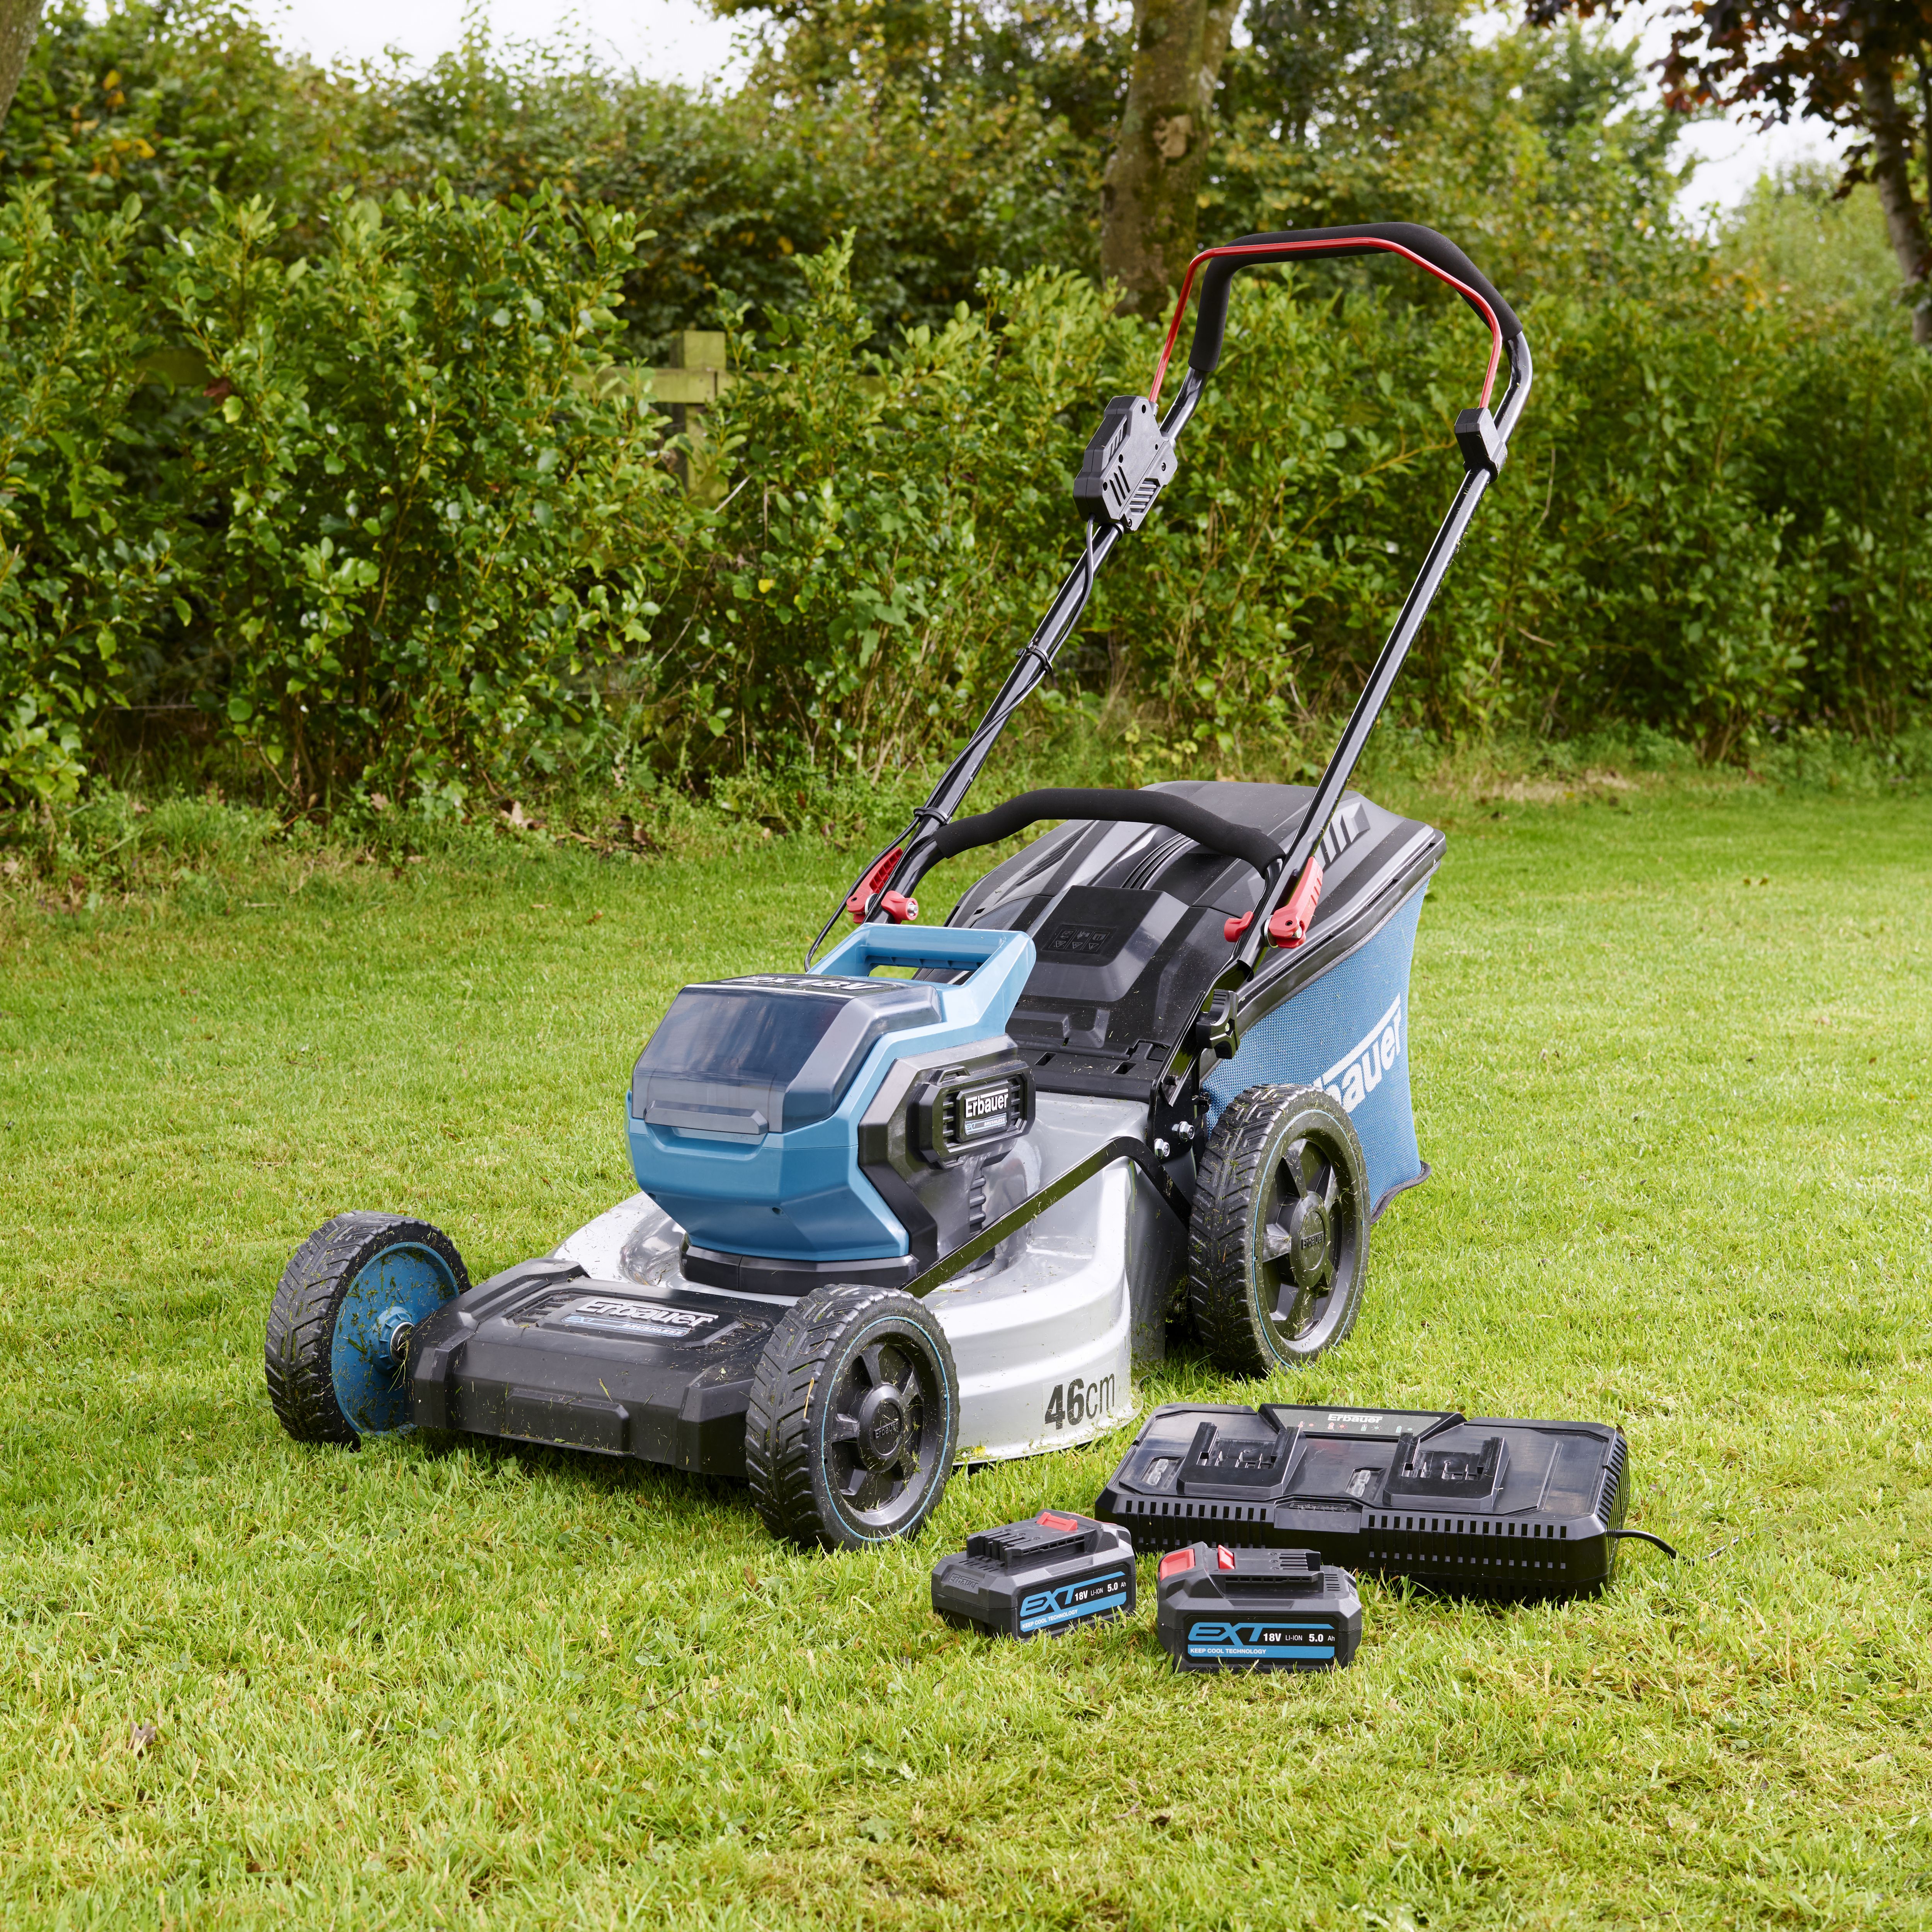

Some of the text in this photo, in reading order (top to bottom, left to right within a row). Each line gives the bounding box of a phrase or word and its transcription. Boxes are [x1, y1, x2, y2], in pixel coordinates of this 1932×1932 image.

[966, 1088, 1008, 1118] Erbauer
[984, 1117, 1005, 1126] BRUSHLESS
[576, 1299, 719, 1327] Erbauer
[621, 1324, 684, 1334] BRUSHLESS
[1045, 1373, 1115, 1430] 46cm
[1328, 1413, 1383, 1423] Erbauer
[873, 1420, 899, 1439] Erbauer
[949, 1573, 980, 1588] Erbauer
[1020, 1585, 1075, 1617] EXT
[1075, 1590, 1088, 1601] 18V
[1090, 1587, 1103, 1596] LI-ION
[1107, 1582, 1118, 1592] 5.0
[1022, 1621, 1034, 1629] KEEP
[1048, 1609, 1078, 1622] TECHNOLOGY
[1188, 1622, 1263, 1645] EXT
[1263, 1633, 1281, 1642] 18V
[1309, 1634, 1323, 1642] 5.0
